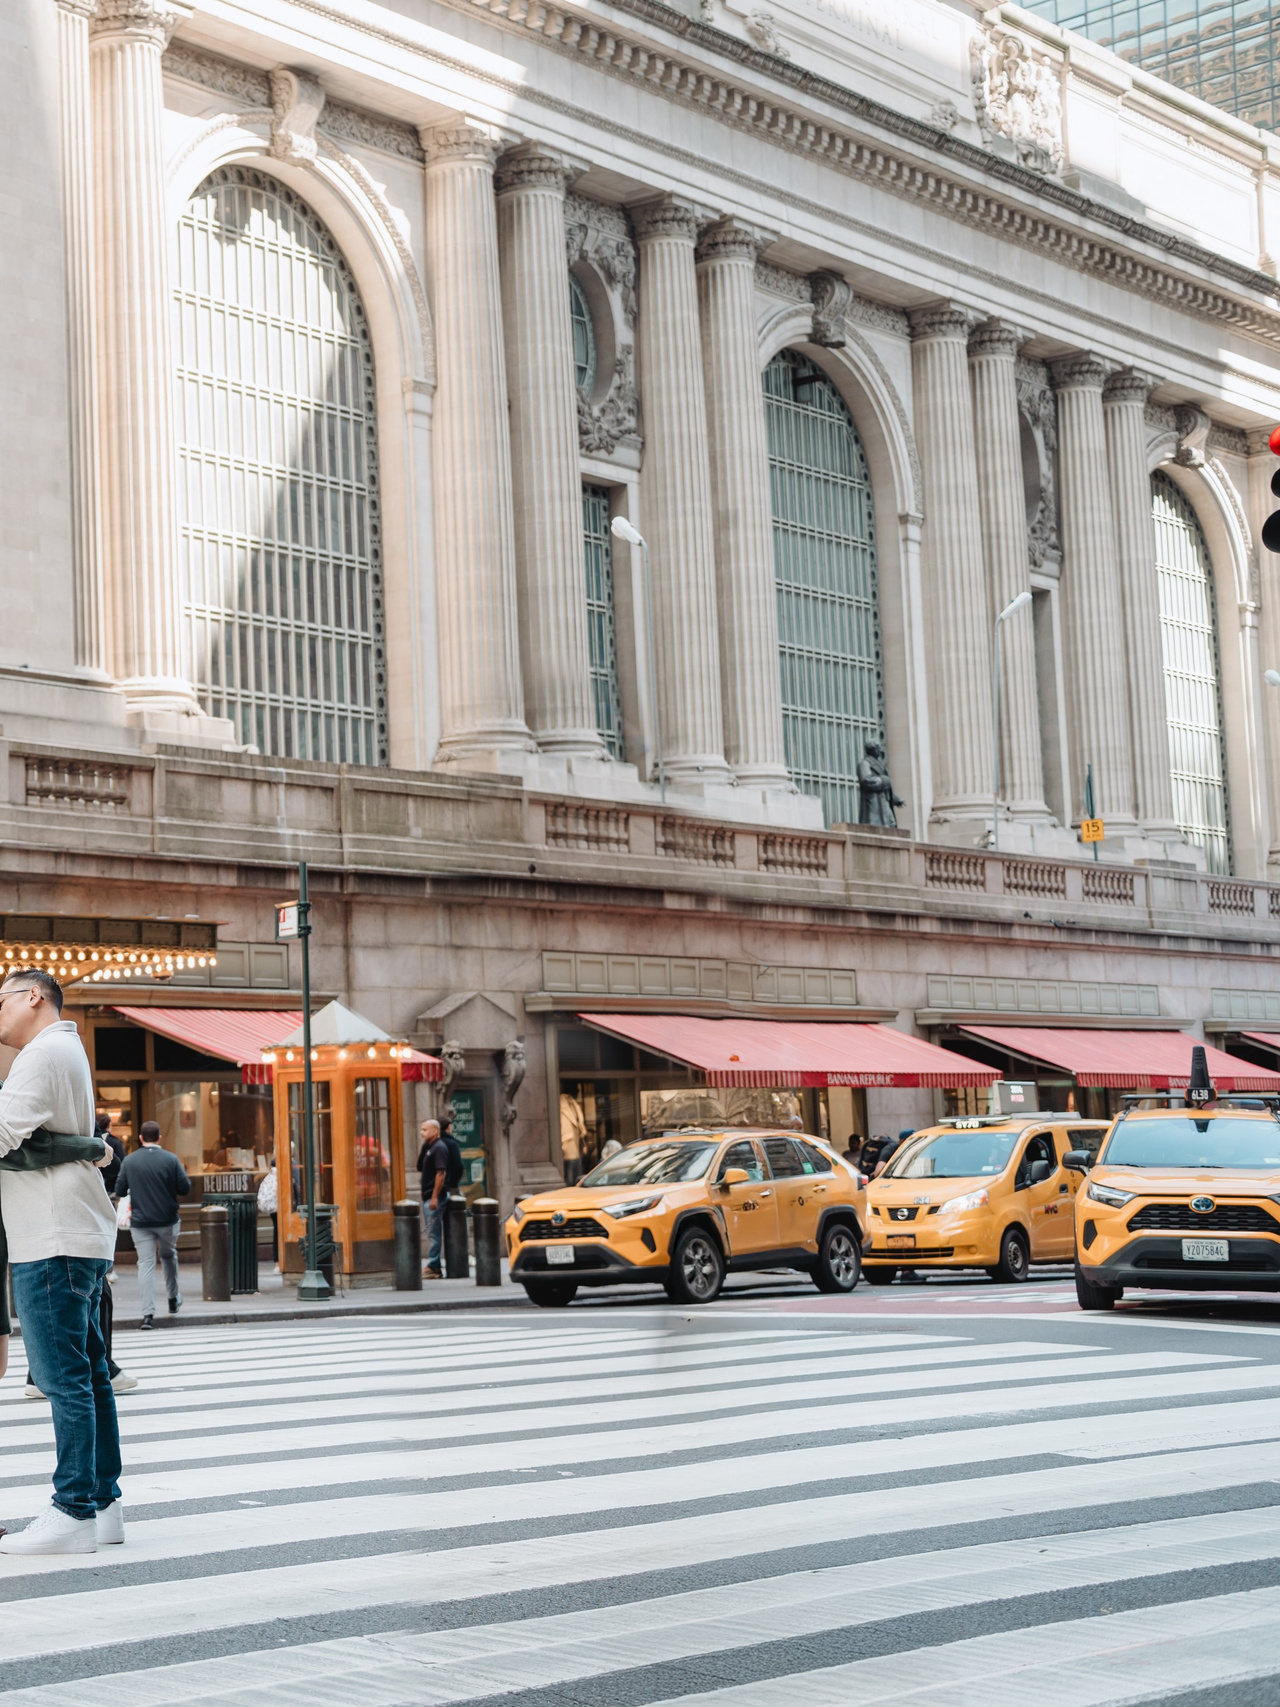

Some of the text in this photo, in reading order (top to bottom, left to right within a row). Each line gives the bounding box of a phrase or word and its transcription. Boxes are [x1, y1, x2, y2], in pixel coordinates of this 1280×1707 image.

[1086, 821, 1100, 833] 15
[827, 1073, 895, 1087] BANANA REPUBLIC
[1191, 1089, 1209, 1100] 6L38
[451, 1099, 471, 1109] Grand
[454, 1110, 474, 1120] entral
[452, 1120, 474, 1132] Official
[203, 1174, 249, 1192] NEUHAUS
[1186, 1244, 1225, 1256] Y207584C
